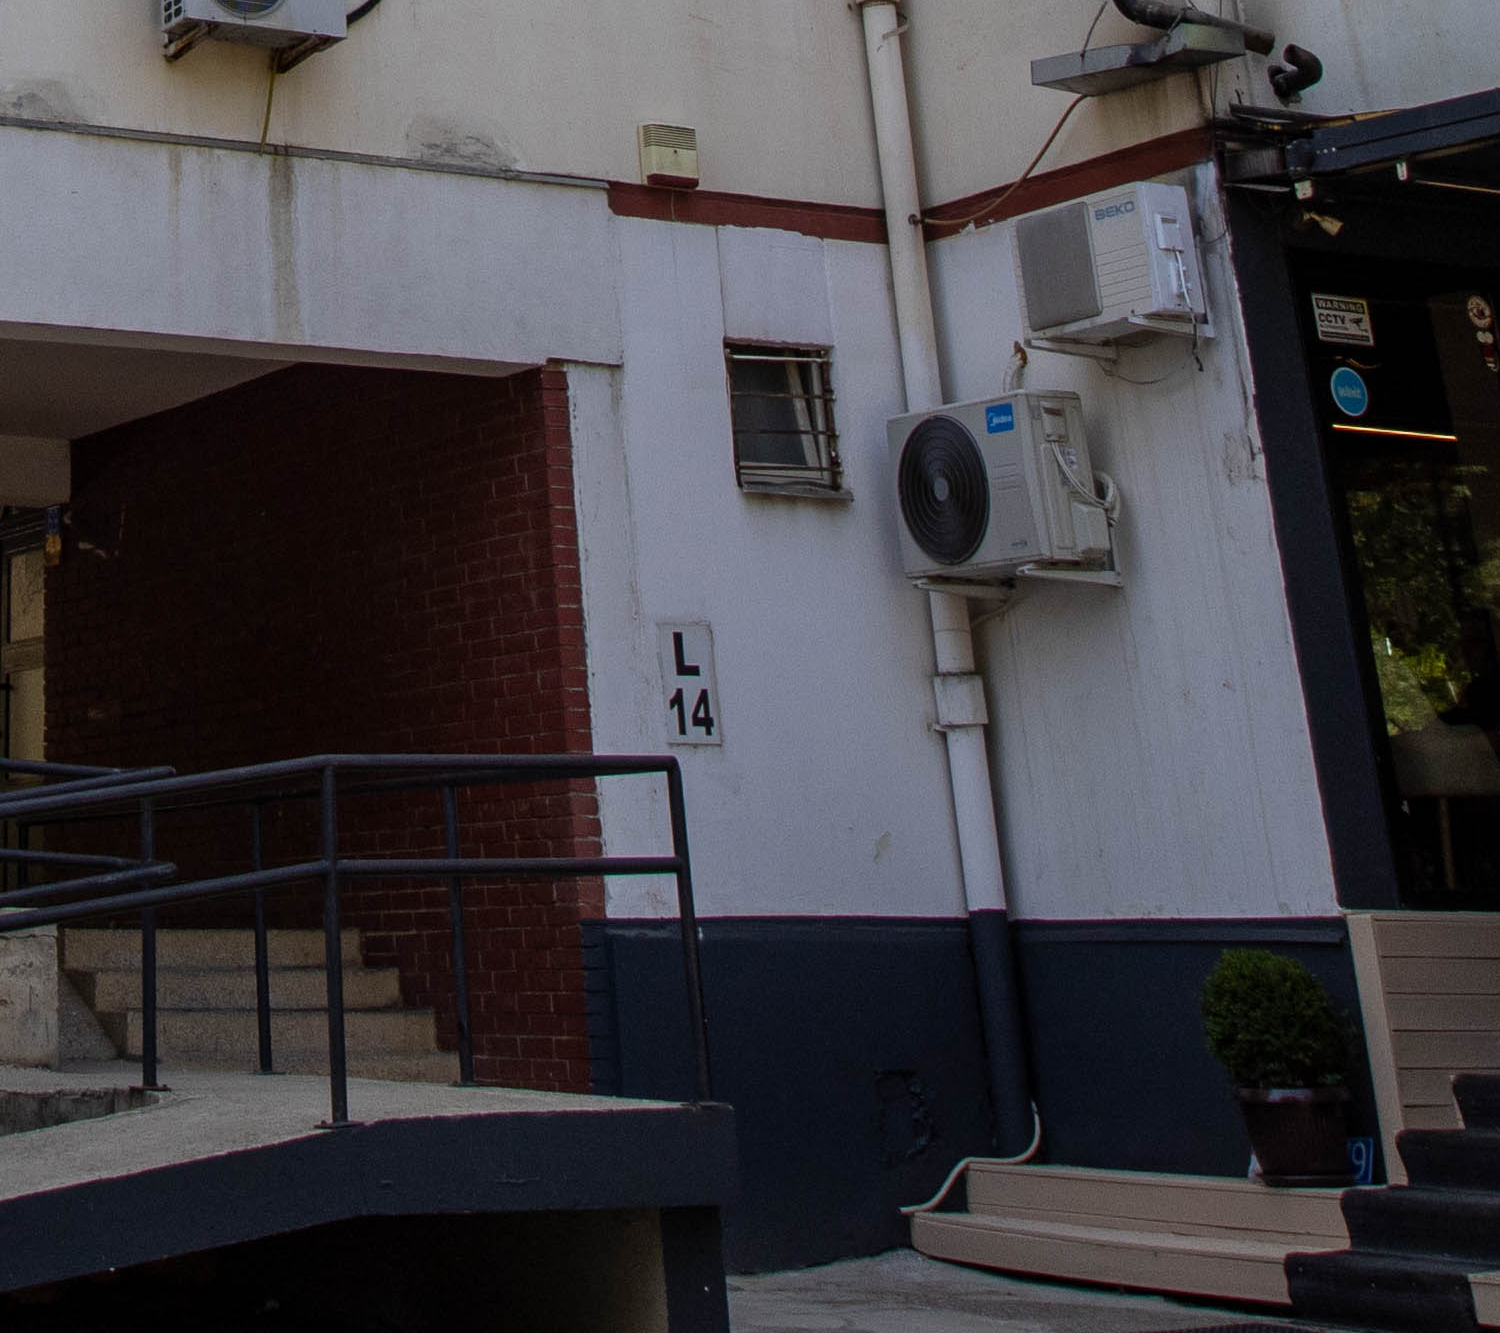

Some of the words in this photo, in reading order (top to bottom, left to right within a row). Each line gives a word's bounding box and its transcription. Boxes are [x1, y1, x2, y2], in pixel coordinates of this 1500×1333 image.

[1095, 200, 1136, 221] BEKO
[1316, 298, 1364, 313] WARNING
[1318, 312, 1346, 325] CCTV
[672, 631, 700, 676] L
[669, 687, 714, 736] 14
